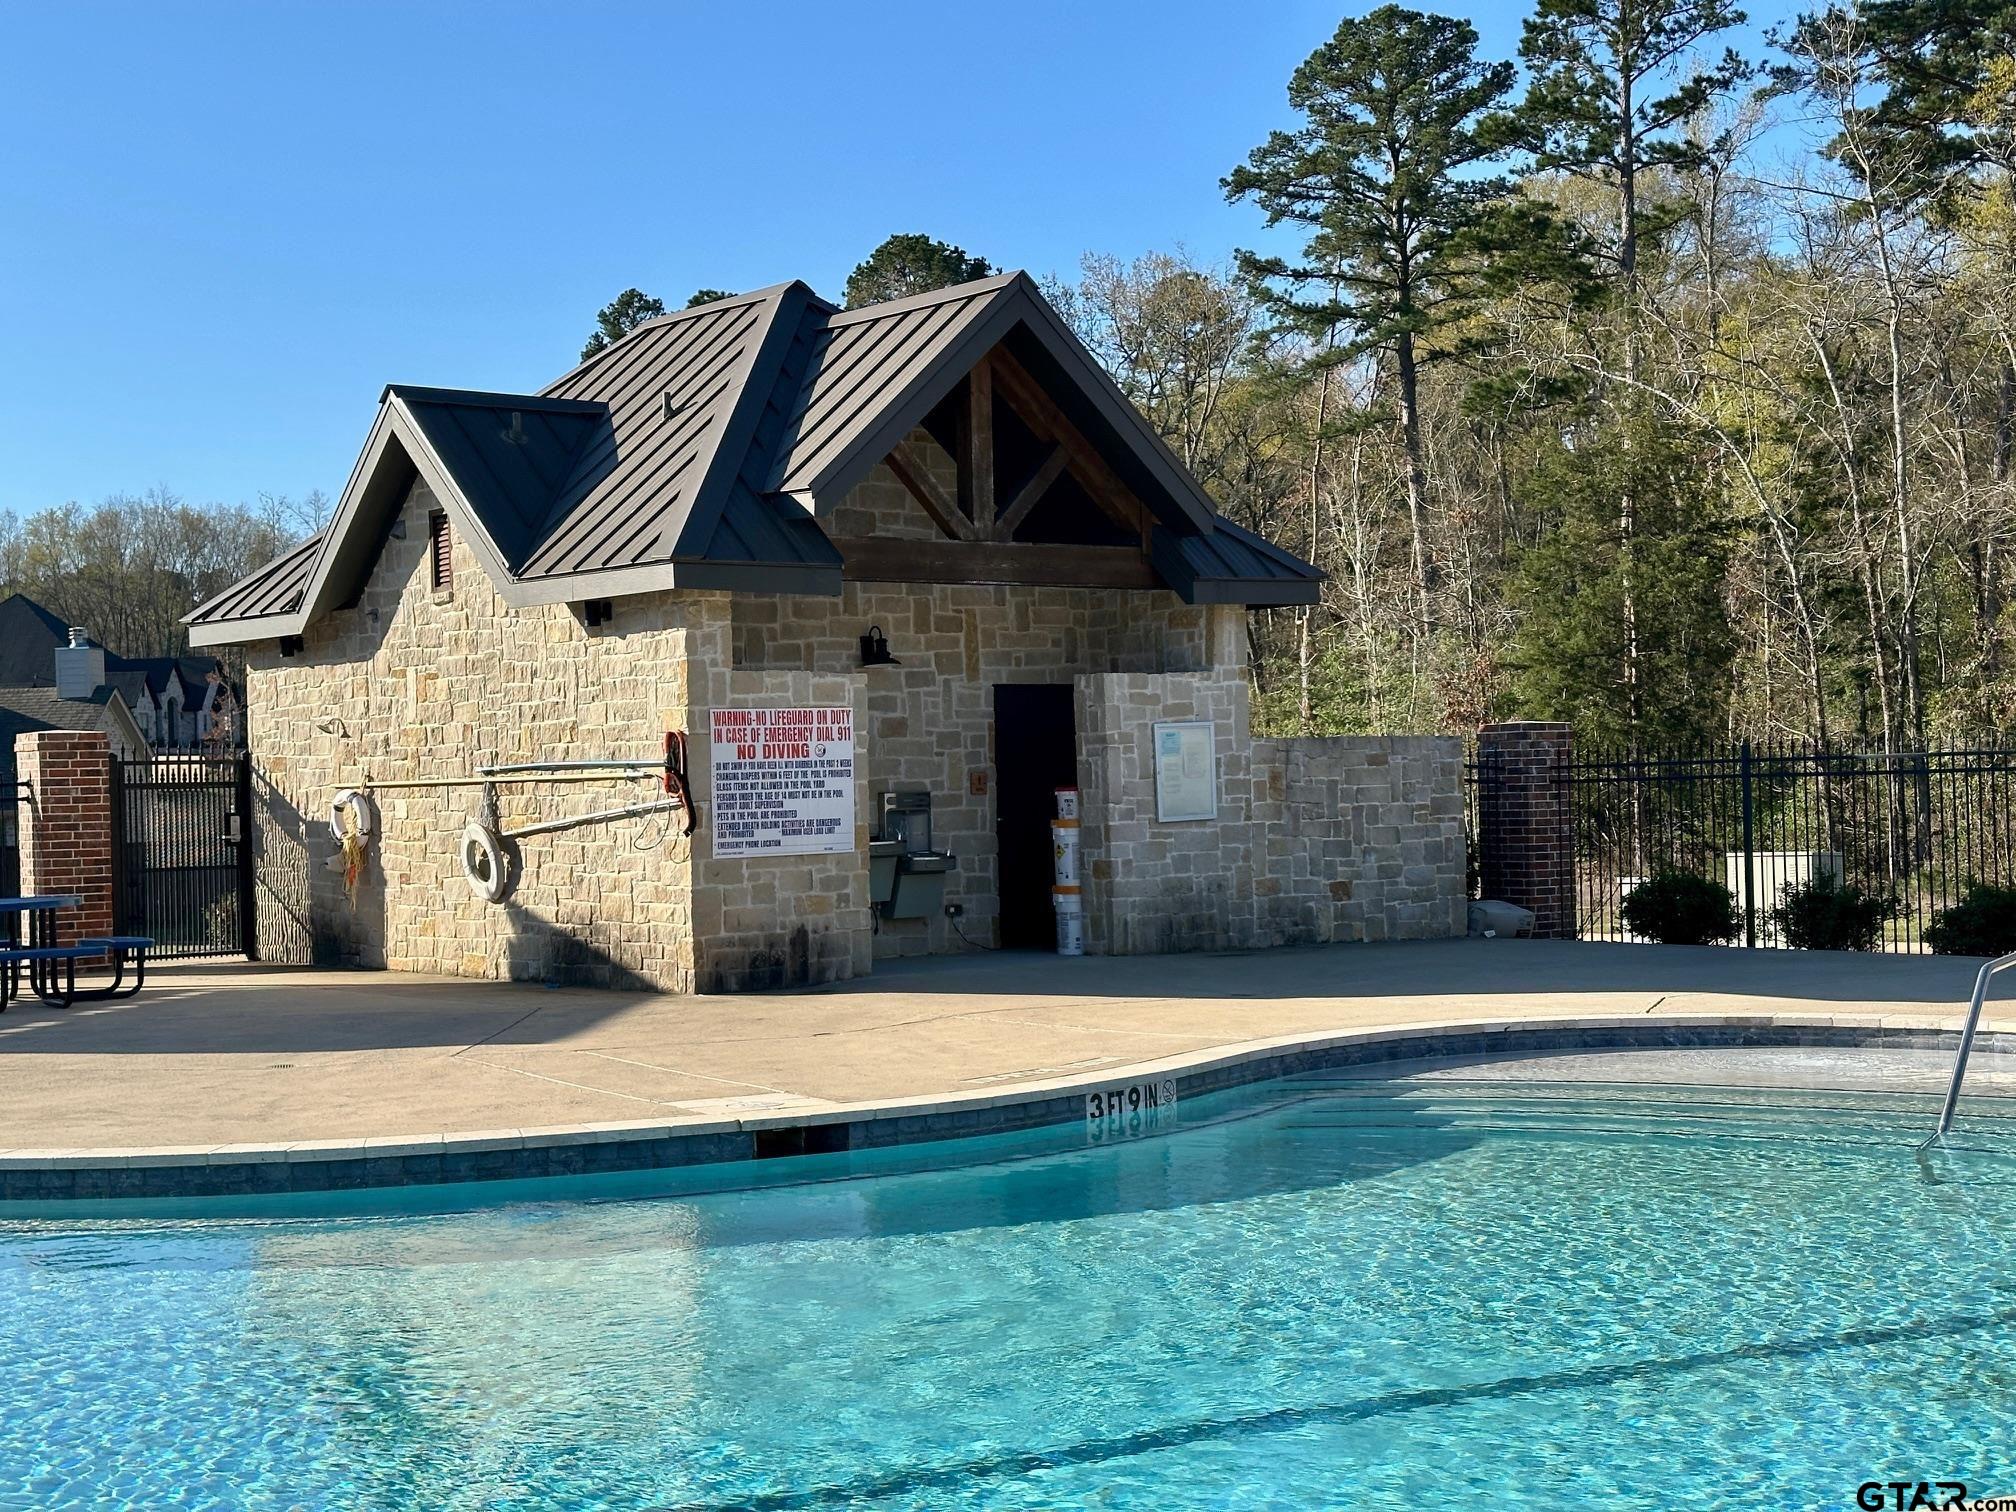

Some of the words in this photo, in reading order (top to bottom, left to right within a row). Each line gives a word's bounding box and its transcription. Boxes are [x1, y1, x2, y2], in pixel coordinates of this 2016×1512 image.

[713, 711, 766, 726] WARNING-NO
[770, 710, 814, 725] LIFEGUARD
[817, 710, 828, 725] ON
[830, 710, 851, 725] DUTY
[714, 728, 722, 743] IN
[726, 728, 748, 743] CASE
[750, 727, 760, 742] OF
[764, 726, 814, 742] EMERGENCY
[816, 726, 834, 742] DIAL
[838, 726, 850, 741] 911
[738, 744, 756, 759] NO
[763, 743, 810, 759] DIVING
[716, 782, 732, 791] GLASS
[734, 782, 748, 790] ITEMS
[750, 782, 759, 790] NOT
[761, 781, 782, 790] ALLOWED
[784, 781, 789, 789] IN
[790, 781, 799, 789] THE
[800, 780, 811, 789] POOL
[813, 780, 825, 788] YARD
[717, 793, 737, 802] PERSONS
[739, 792, 753, 801] UNDER
[755, 792, 764, 800] THE
[765, 792, 773, 800] AGE
[774, 792, 780, 800] OF
[782, 791, 786, 800] 14
[788, 791, 800, 799] MUST
[802, 791, 810, 799] NOT
[812, 790, 817, 799] BE
[818, 790, 822, 798] IN
[833, 790, 843, 798] POOL
[717, 802, 737, 810] WITHOUT
[739, 801, 752, 810] ADULT
[755, 801, 783, 809] SUPERVISION
[717, 812, 729, 821] PETS
[730, 812, 735, 820] IN
[737, 812, 746, 820] THE
[747, 811, 759, 820] POOL
[760, 811, 770, 819] ARE
[771, 810, 797, 819] PROHIBITED
[1090, 1093, 1104, 1119] 3
[1108, 1090, 1124, 1116] FT
[1128, 1086, 1140, 1112] 9
[1144, 1084, 1158, 1109] IN
